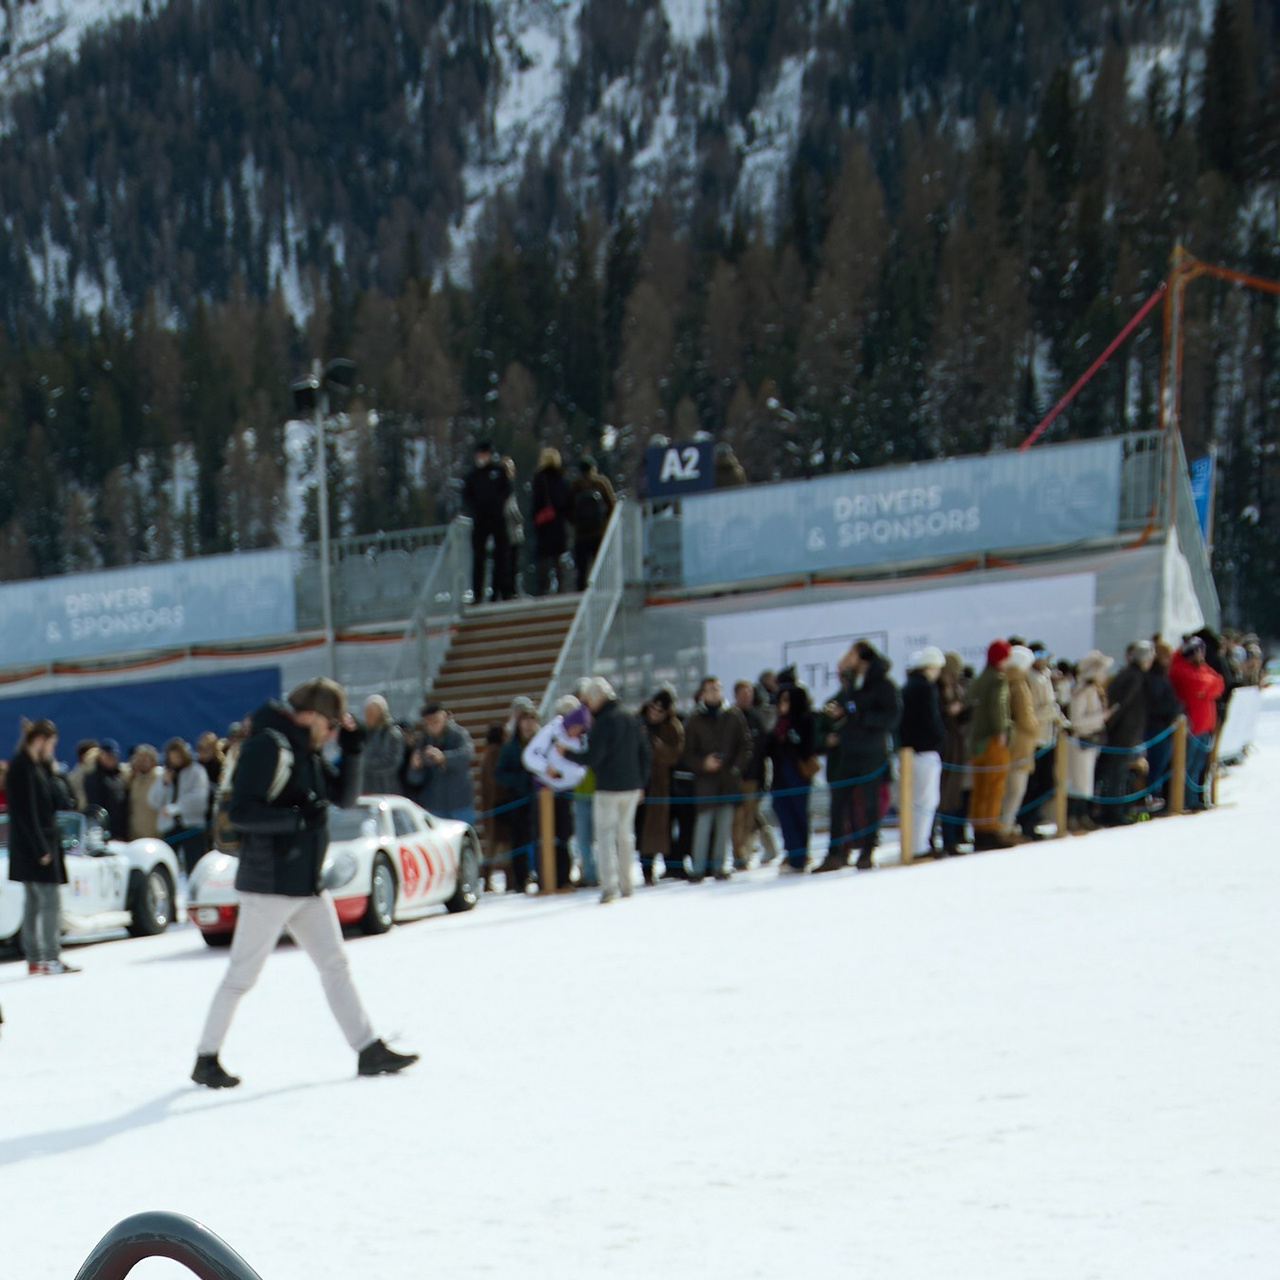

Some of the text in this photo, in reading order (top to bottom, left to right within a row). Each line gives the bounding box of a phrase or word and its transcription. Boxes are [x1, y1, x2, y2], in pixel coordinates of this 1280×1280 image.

[661, 446, 701, 483] A2
[834, 485, 943, 521] DRIVERS
[806, 507, 980, 551] & SPONSORS
[65, 586, 153, 616] DRIVERS
[71, 605, 185, 640] SPONSORS
